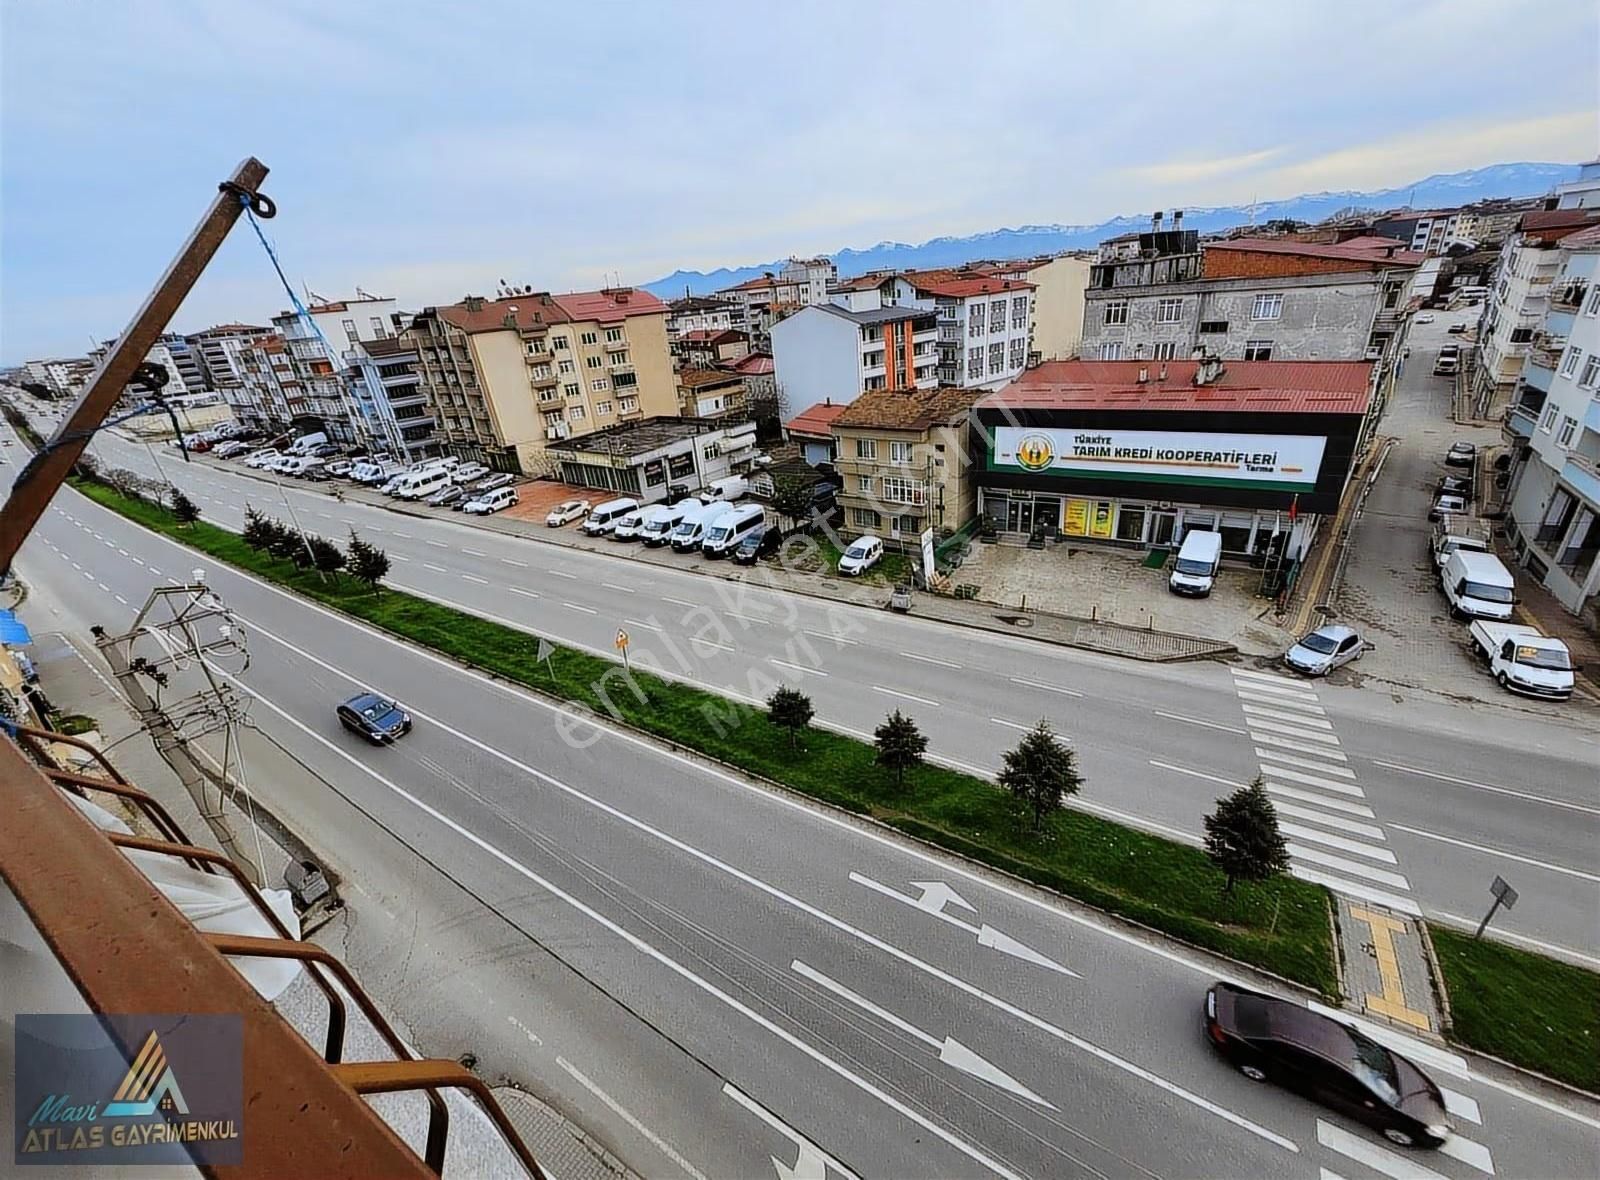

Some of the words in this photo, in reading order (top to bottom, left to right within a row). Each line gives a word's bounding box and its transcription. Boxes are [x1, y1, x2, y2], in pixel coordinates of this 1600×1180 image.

[1072, 445, 1111, 457] TARIM
[1114, 446, 1153, 459] KREDİ
[1156, 449, 1278, 465] KOOPERATİFLERİ
